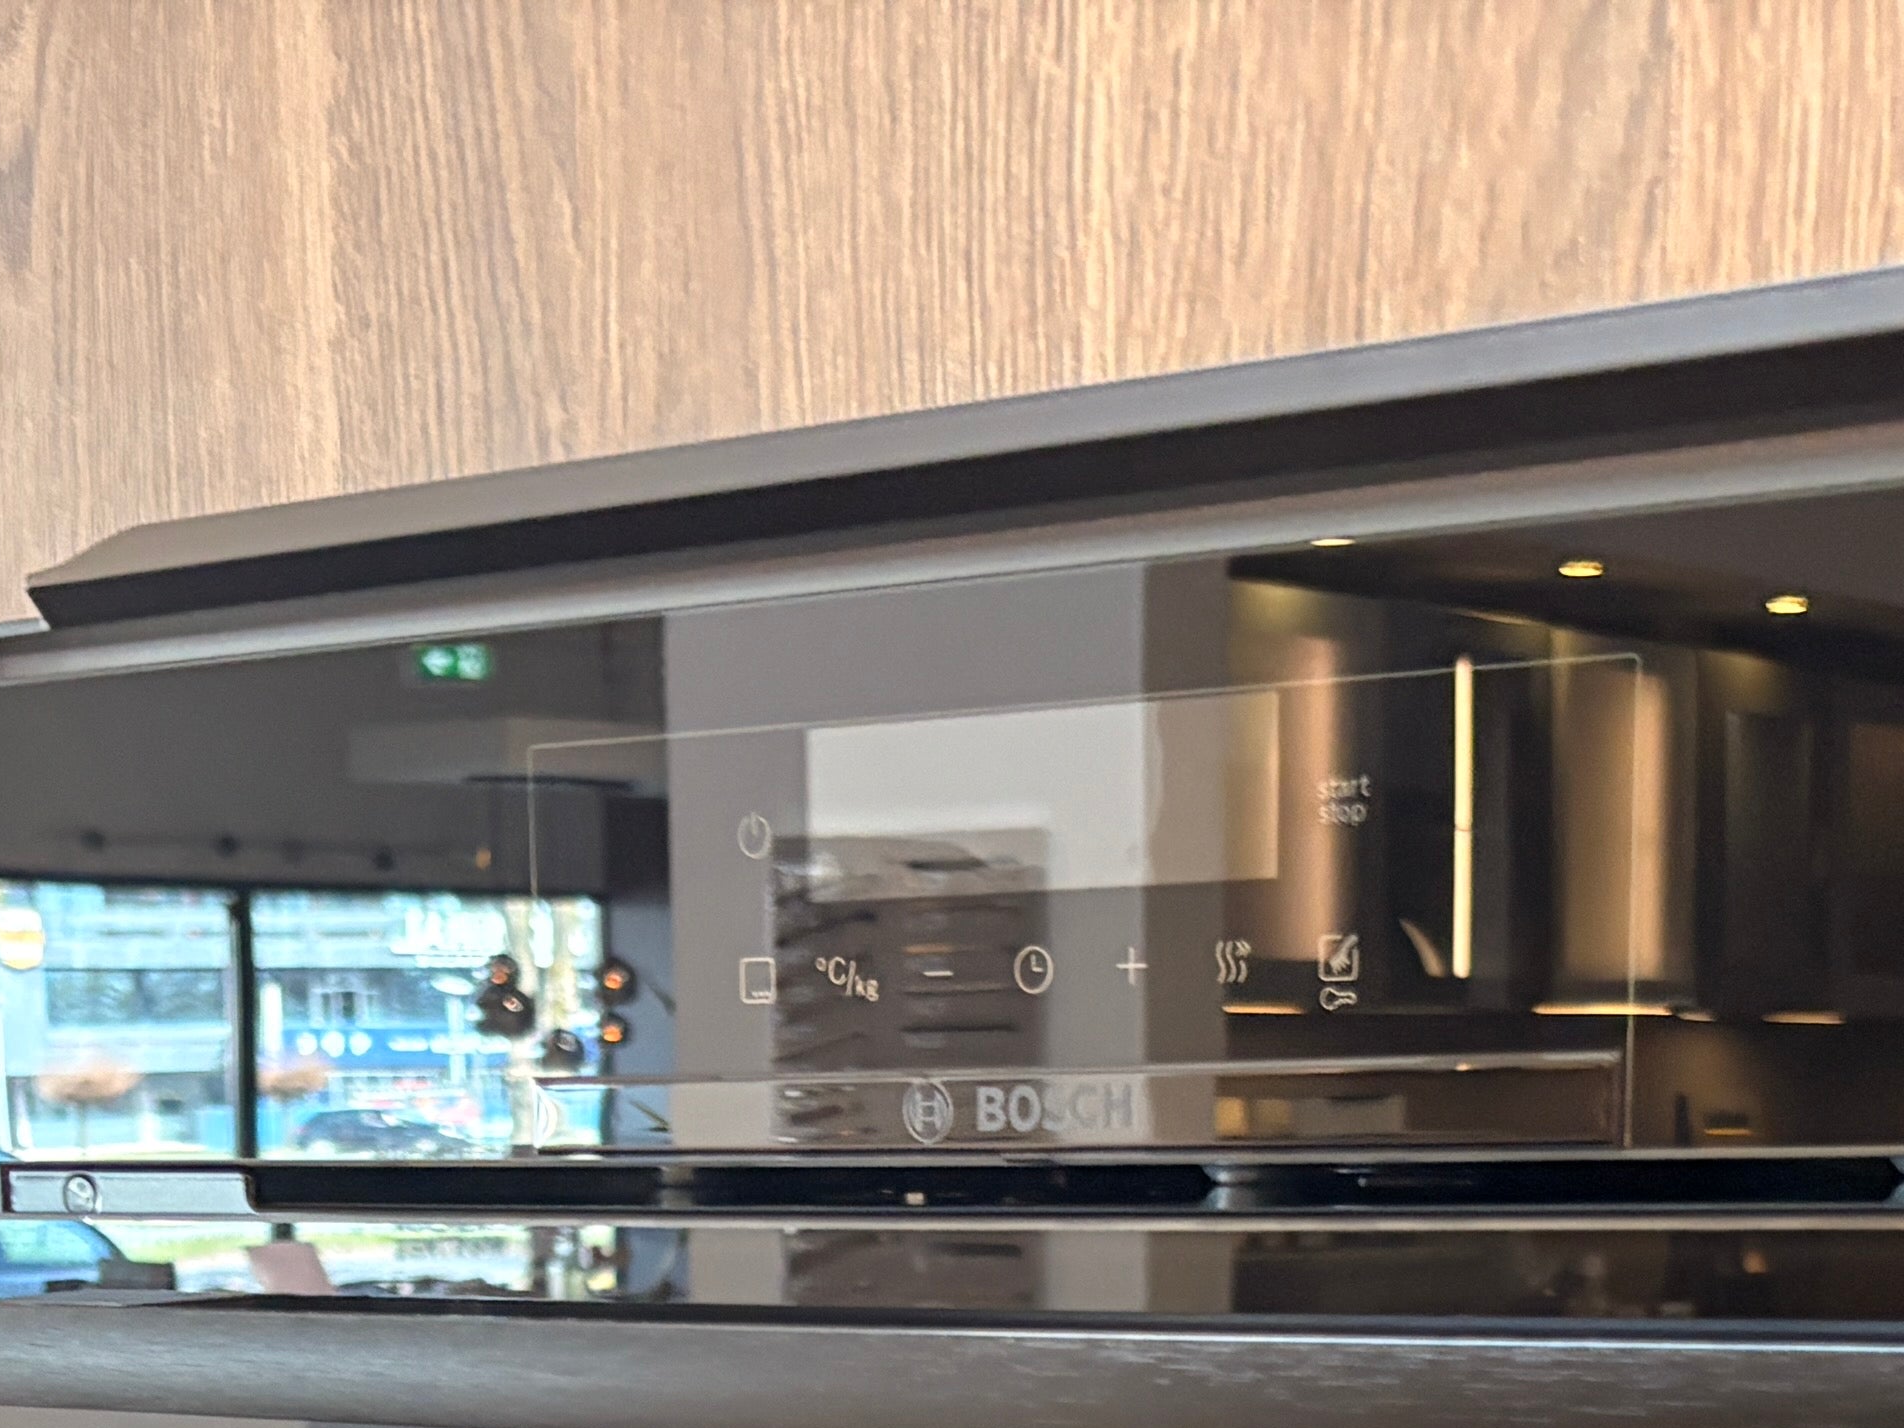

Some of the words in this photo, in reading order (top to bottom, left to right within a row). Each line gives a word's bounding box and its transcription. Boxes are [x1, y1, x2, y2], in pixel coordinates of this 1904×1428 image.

[1316, 775, 1371, 799] start
[1317, 801, 1367, 826] stop
[975, 1083, 1134, 1133] BOSCH
